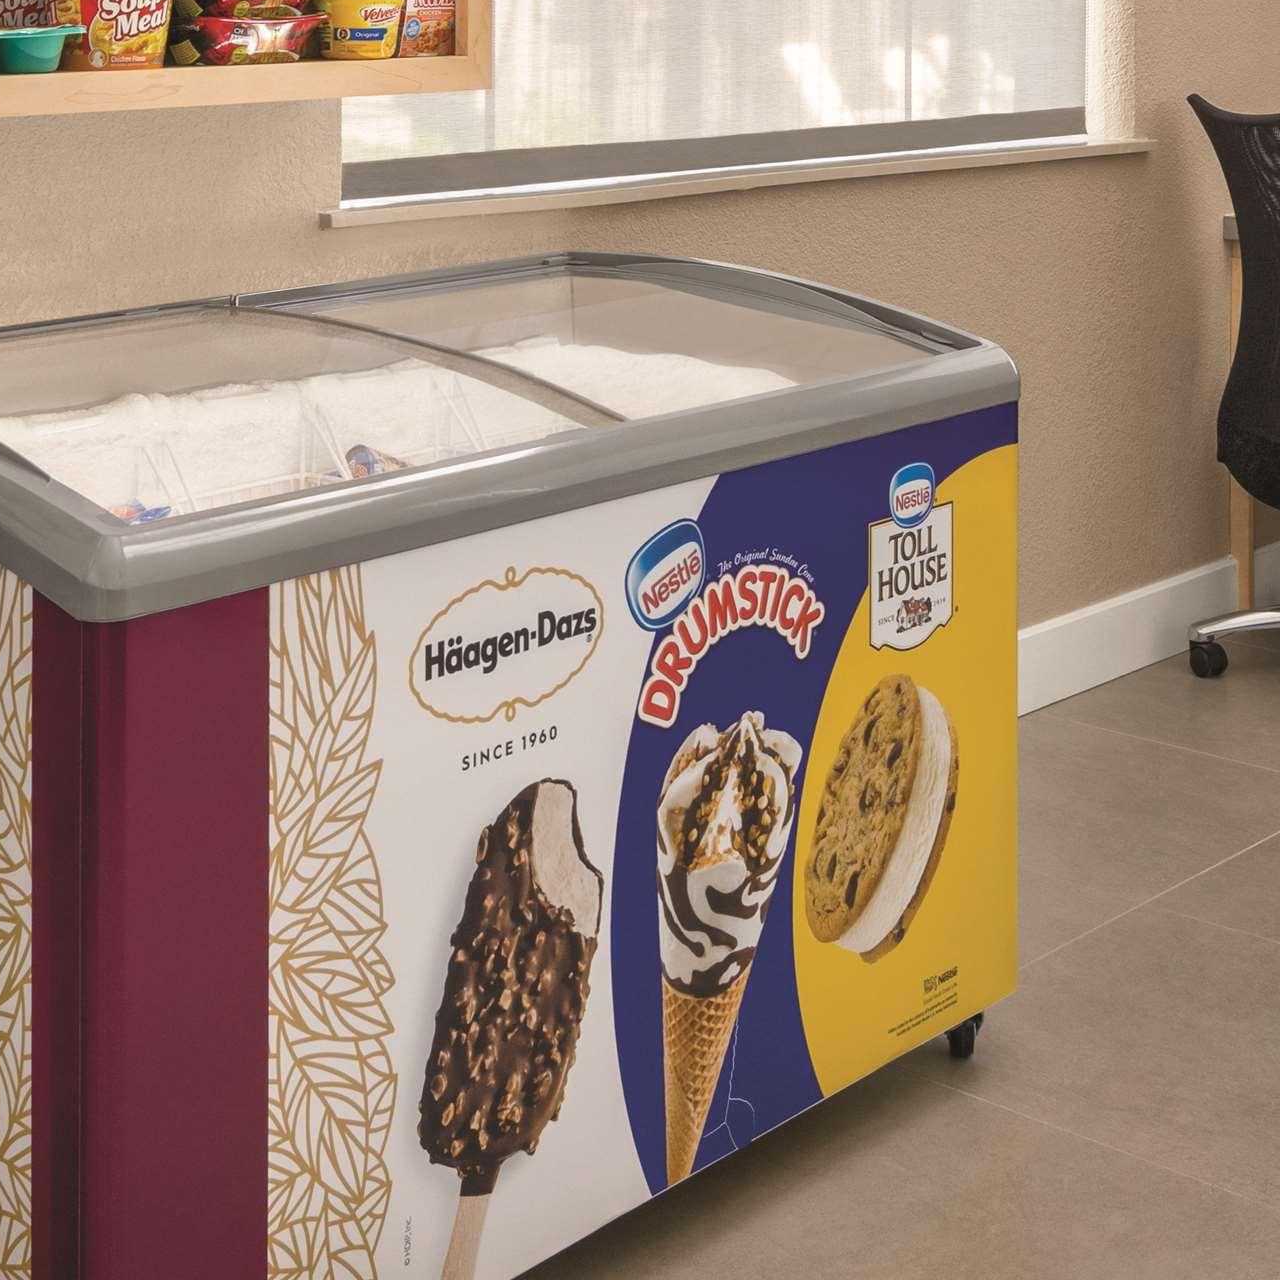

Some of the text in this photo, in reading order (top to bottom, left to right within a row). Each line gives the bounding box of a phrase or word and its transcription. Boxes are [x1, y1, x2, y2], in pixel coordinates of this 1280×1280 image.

[115, 0, 168, 40] Meal
[354, 30, 380, 39] Original
[895, 485, 931, 513] Nestlé
[717, 547, 815, 584] The Original Sundae Cone
[888, 524, 938, 565] TOLL
[641, 548, 701, 615] Nestlé
[877, 552, 948, 603] HOUSE
[424, 607, 598, 682] Häagen-Dazs
[640, 569, 822, 723] DRUMSTICK
[460, 724, 558, 771] SINCE 1960
